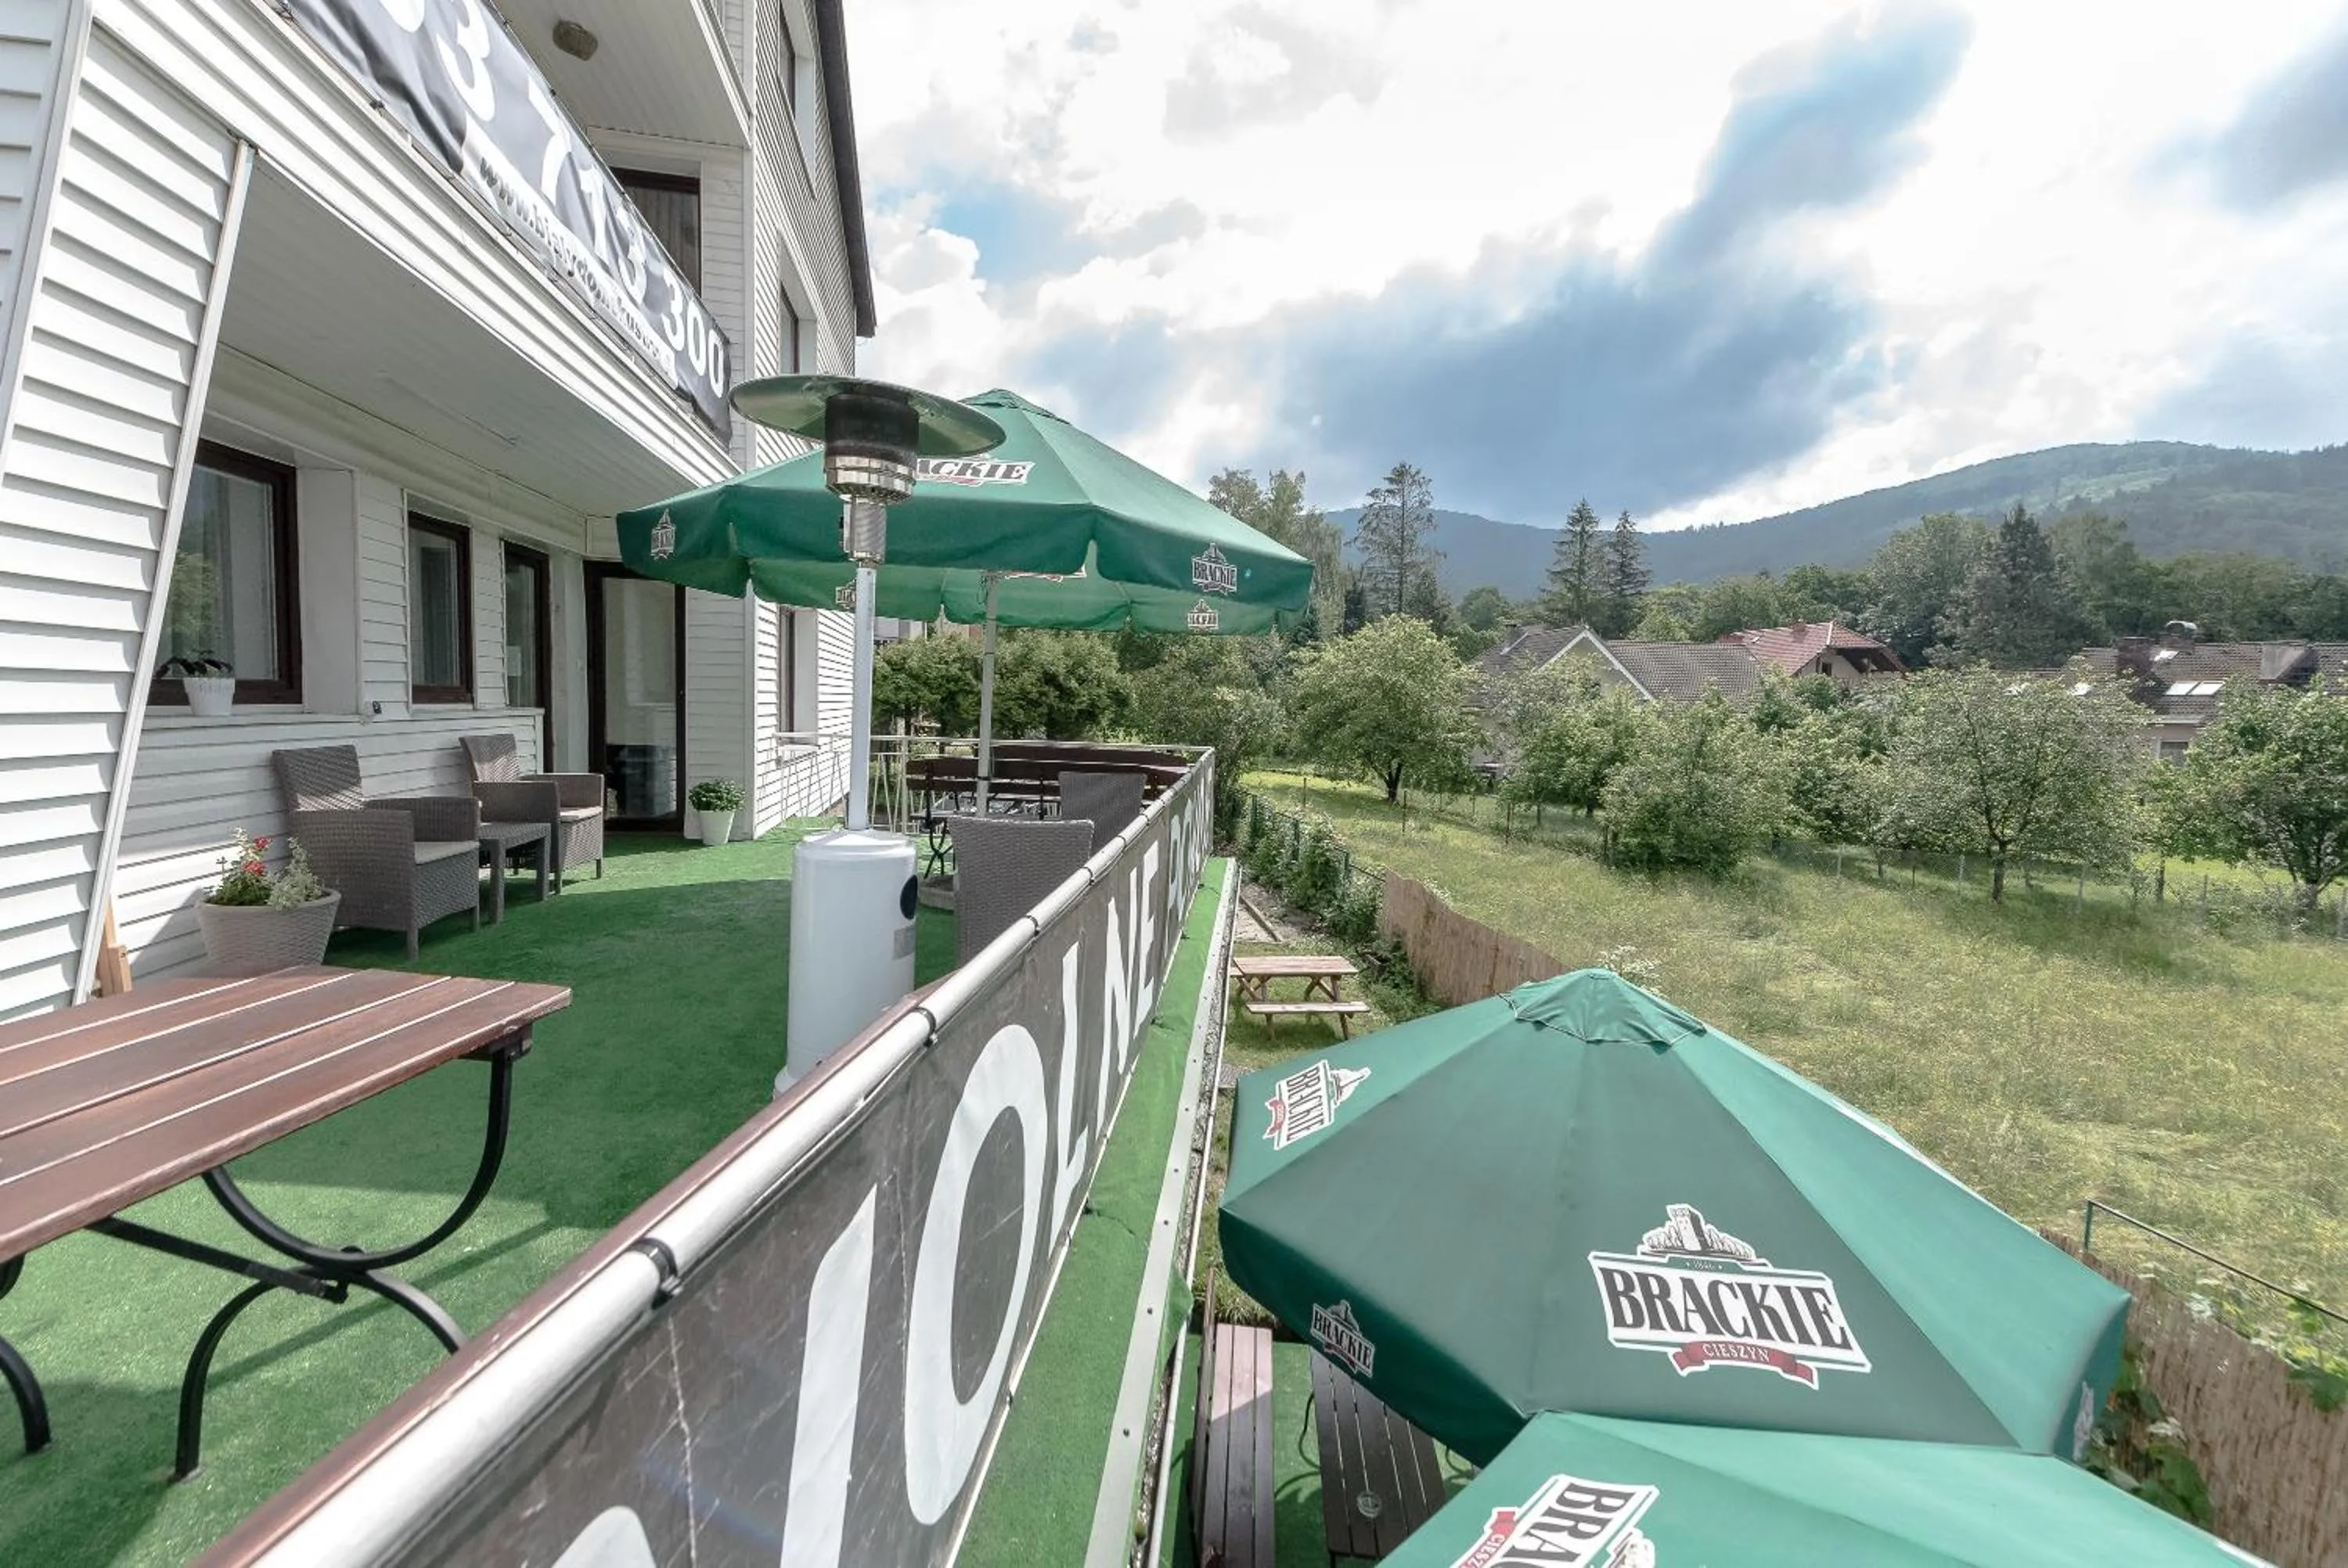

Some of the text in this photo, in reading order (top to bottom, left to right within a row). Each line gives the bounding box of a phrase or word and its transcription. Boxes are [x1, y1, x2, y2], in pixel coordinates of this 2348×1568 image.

[661, 266, 723, 397] 300
[1286, 1066, 1324, 1141] BRACKIE
[1315, 1309, 1371, 1369] BRACKIE
[1598, 1267, 1853, 1350] BRACKIE
[1702, 1343, 1769, 1362] CIESZYN
[1460, 1534, 1505, 1567] CIESZ
[1491, 1483, 1636, 1567] BRA
